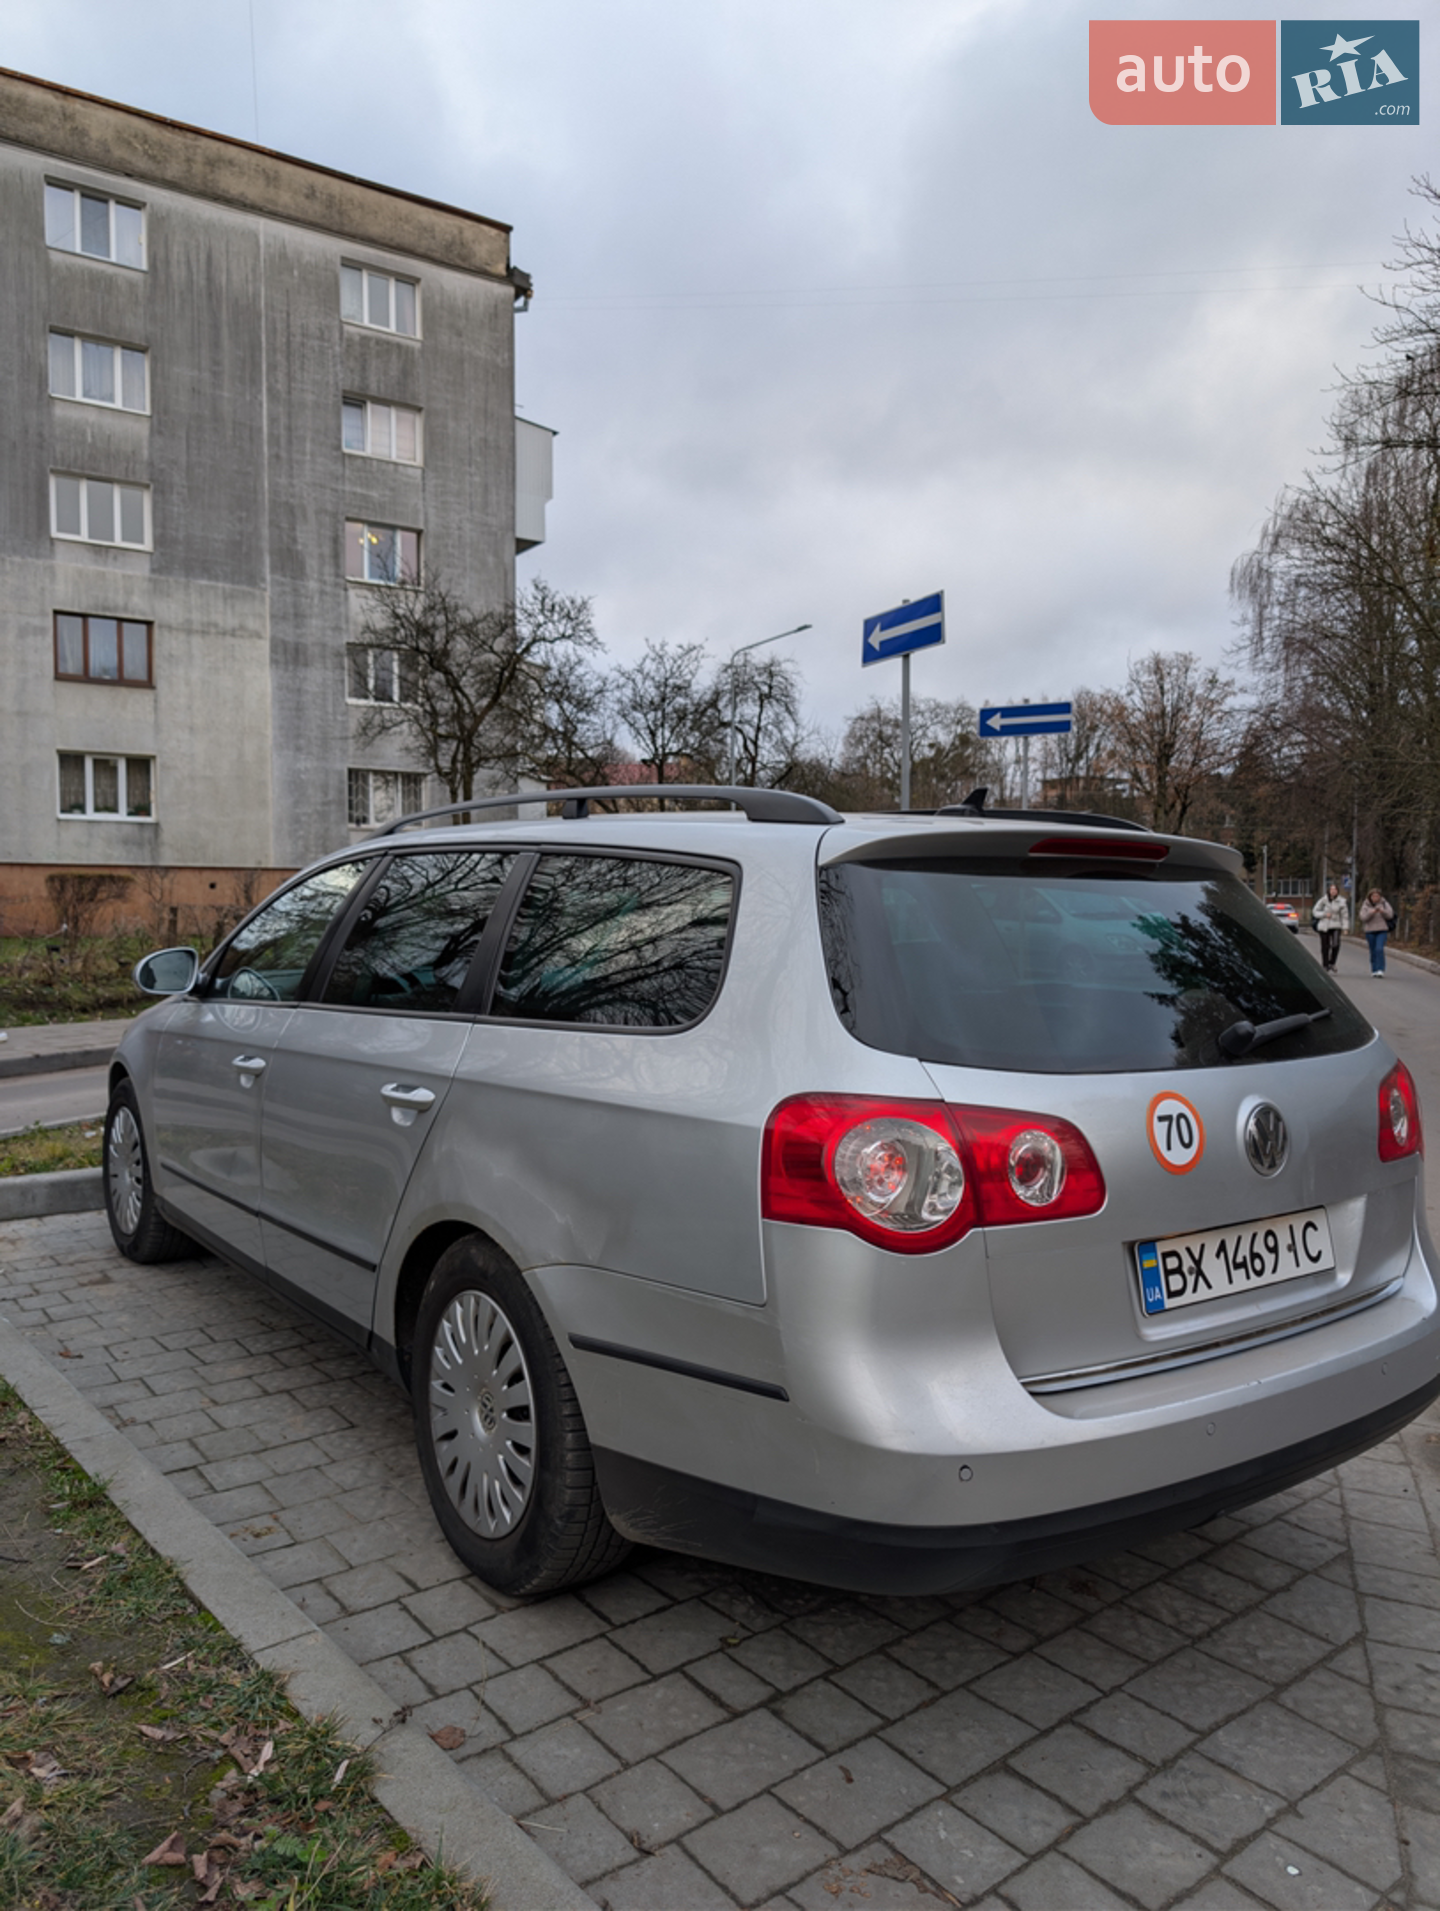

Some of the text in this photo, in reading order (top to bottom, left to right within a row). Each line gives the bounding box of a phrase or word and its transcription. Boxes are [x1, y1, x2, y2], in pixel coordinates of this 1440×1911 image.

[1157, 1112, 1194, 1151] 70
[1161, 1220, 1323, 1299] BX 1469 IC
[1146, 1285, 1162, 1302] UA
